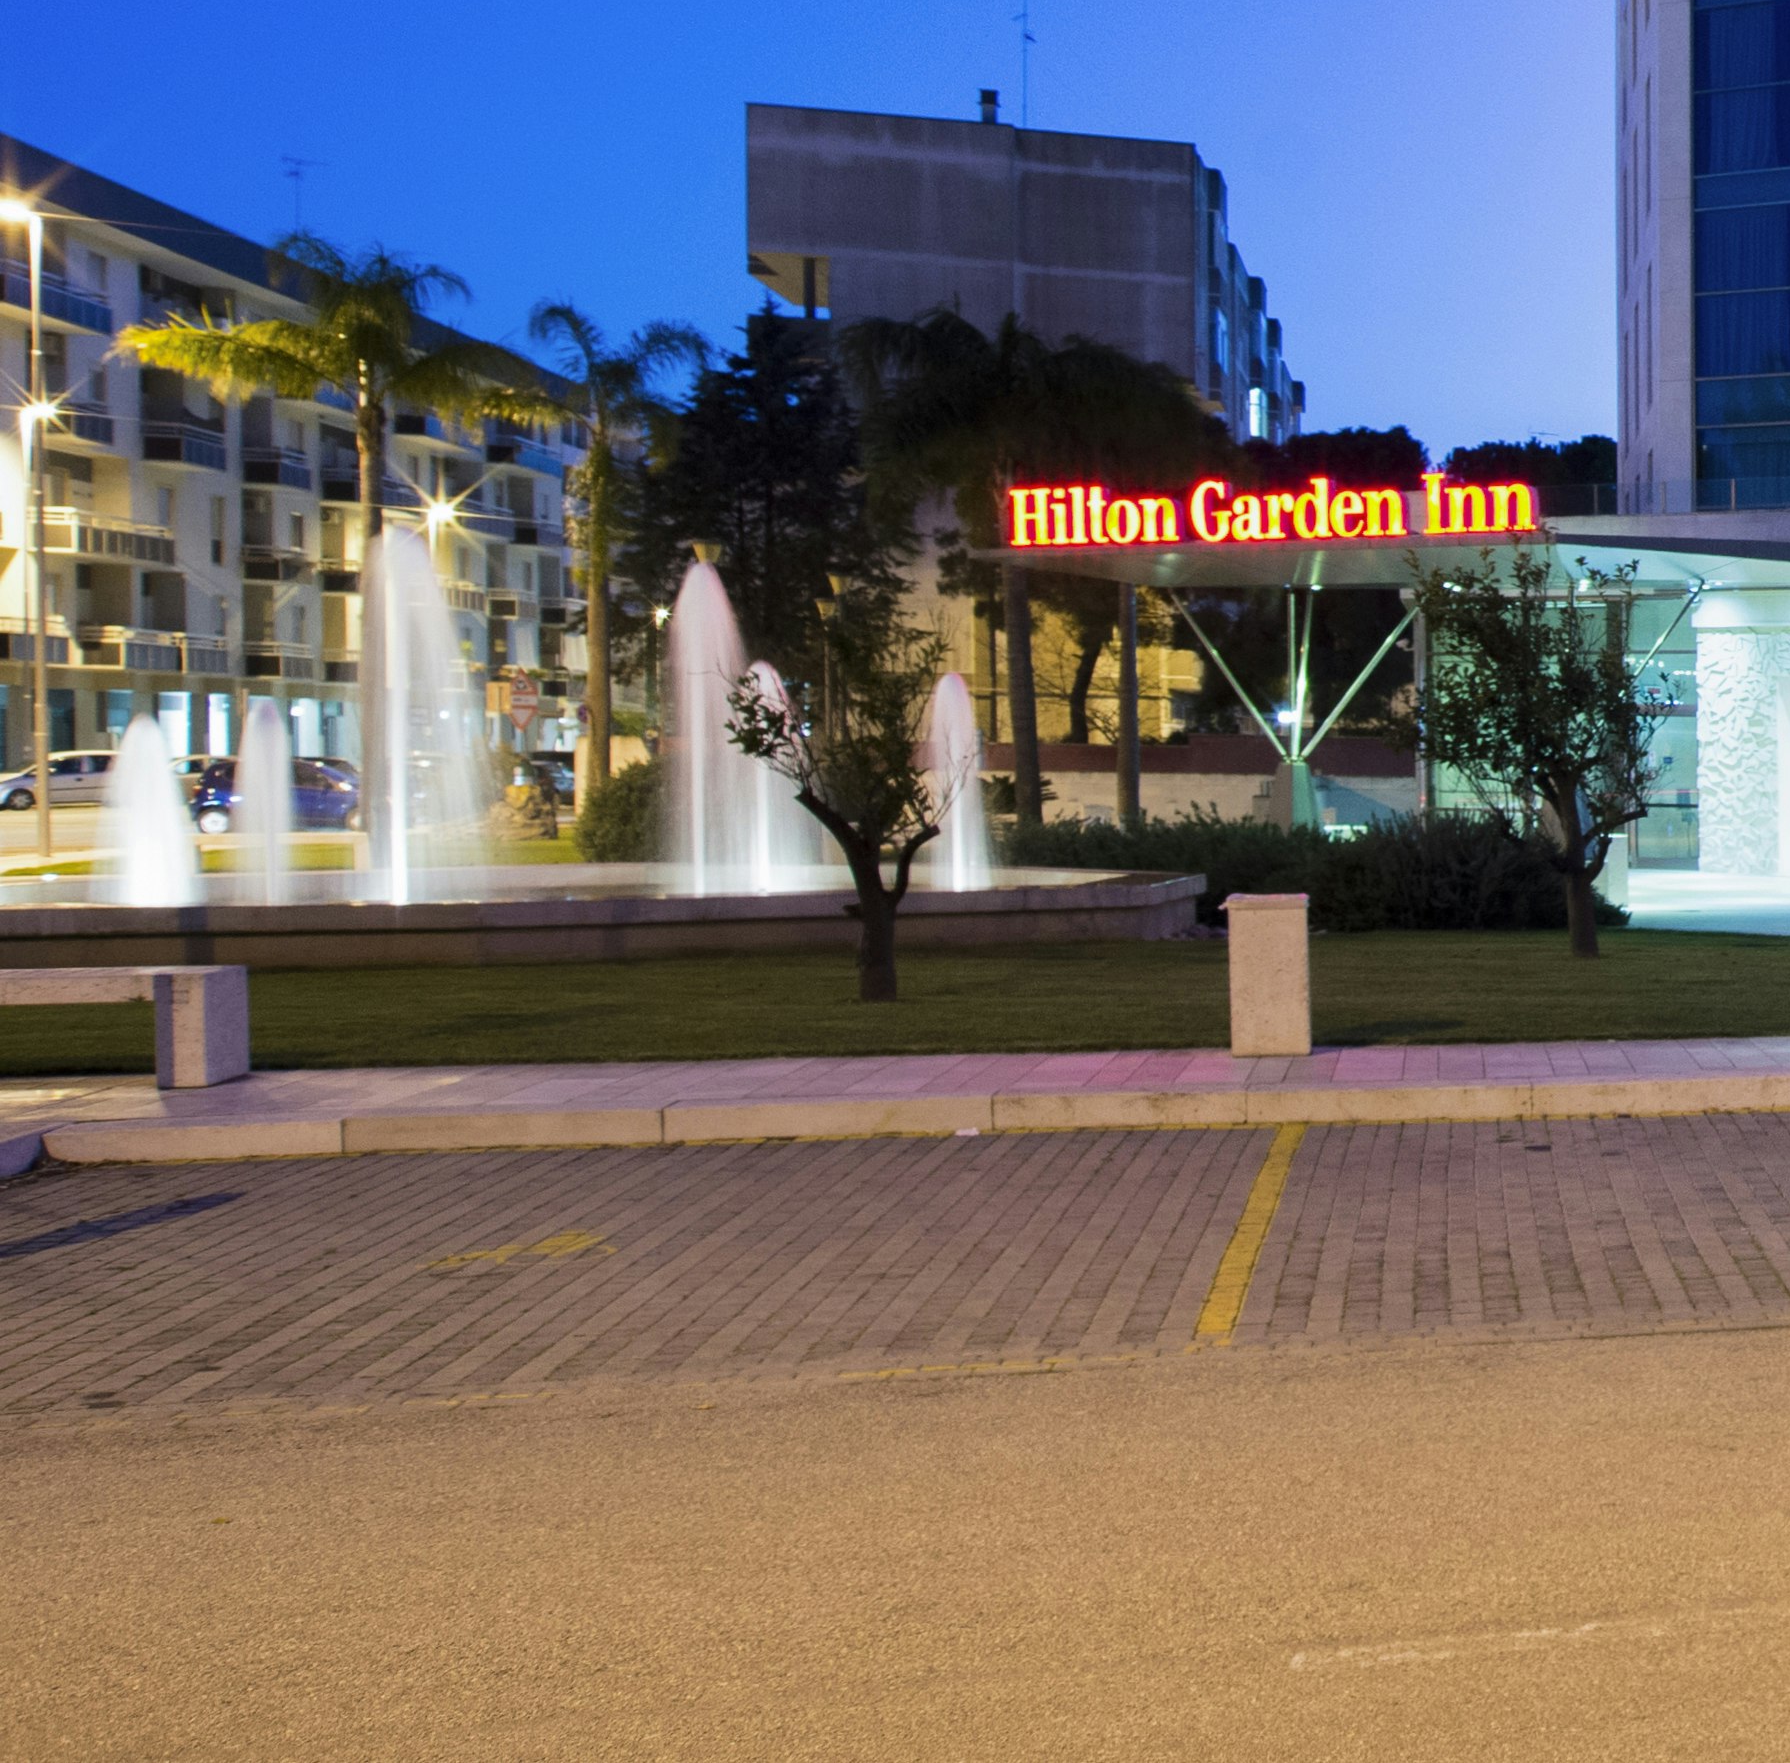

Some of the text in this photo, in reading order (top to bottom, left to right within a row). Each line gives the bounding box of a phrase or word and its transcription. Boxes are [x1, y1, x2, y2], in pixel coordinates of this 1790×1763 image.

[1008, 472, 1537, 546] Hilton Garden Inn
